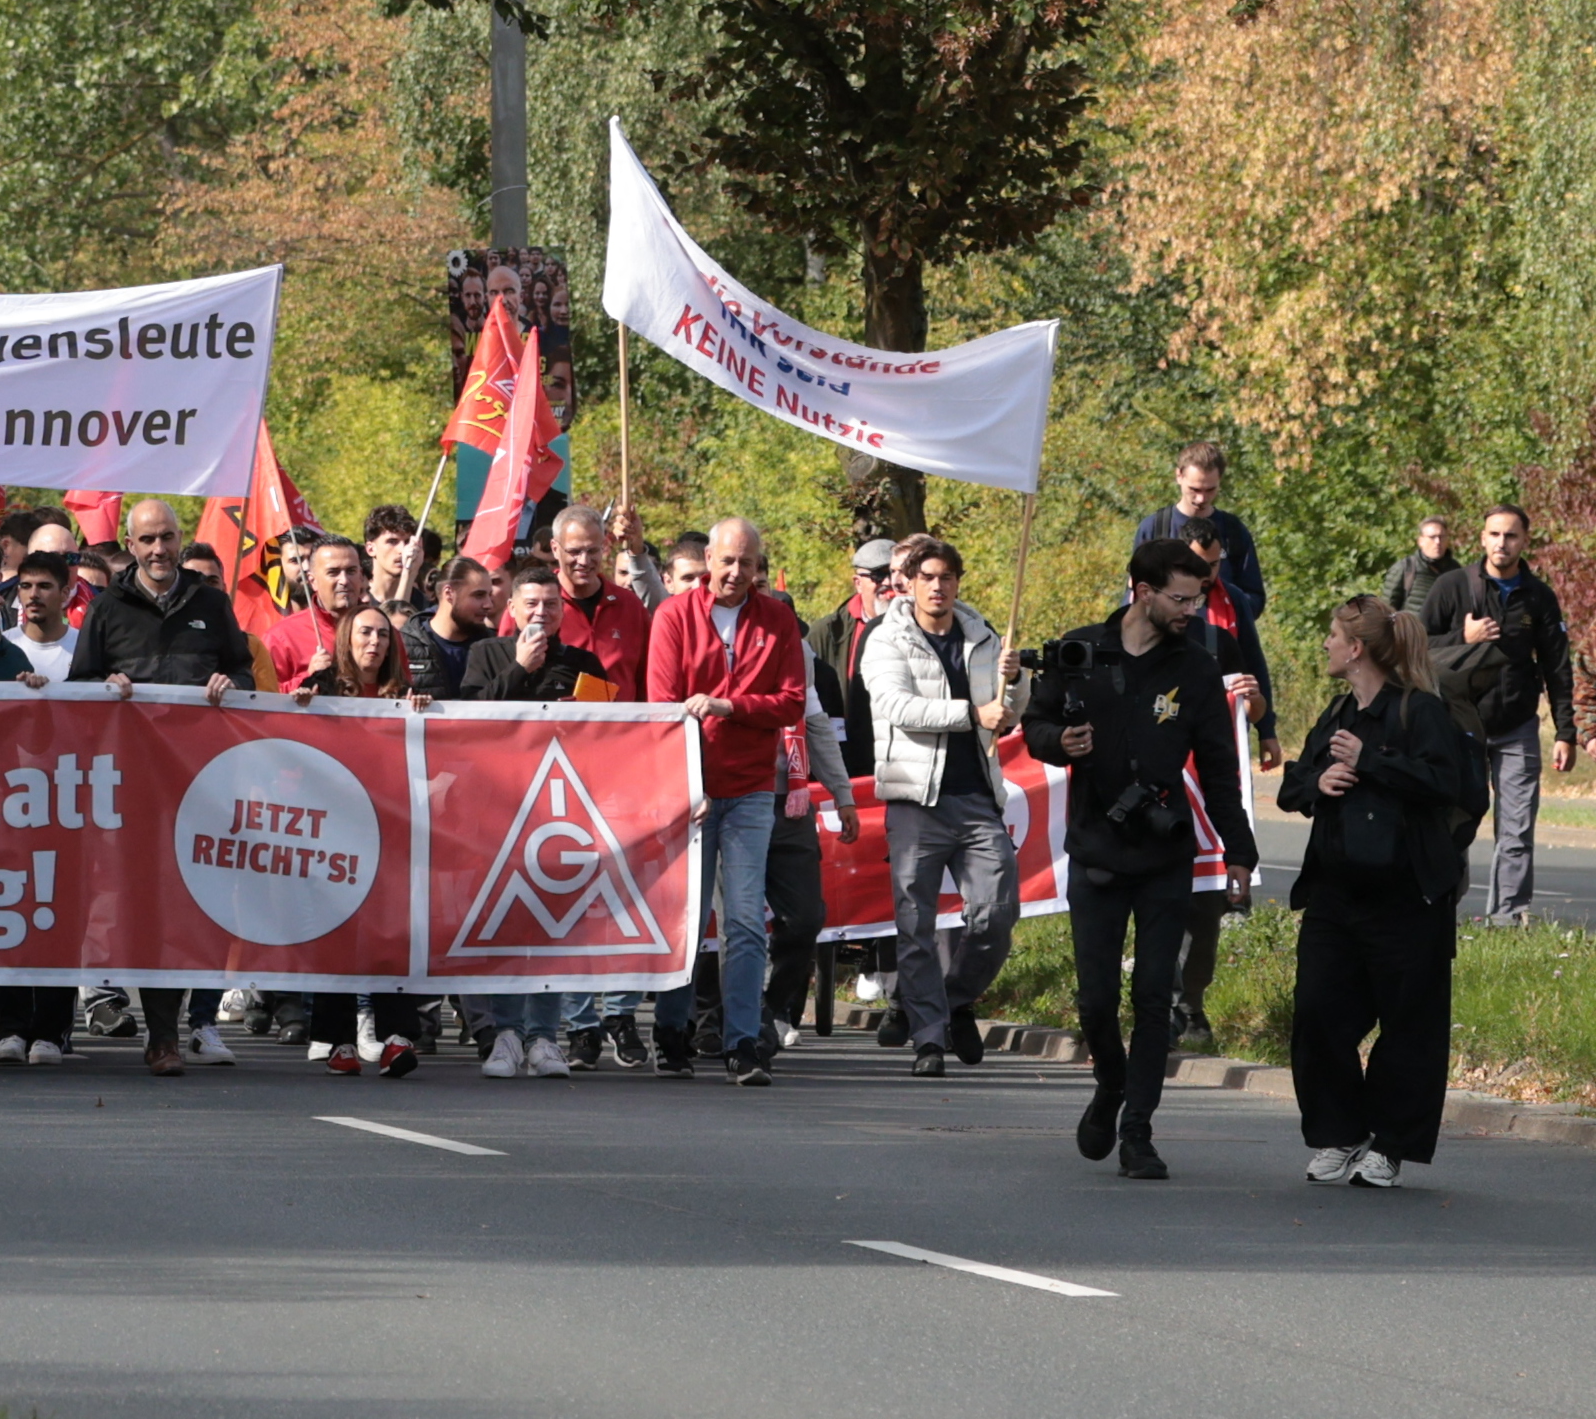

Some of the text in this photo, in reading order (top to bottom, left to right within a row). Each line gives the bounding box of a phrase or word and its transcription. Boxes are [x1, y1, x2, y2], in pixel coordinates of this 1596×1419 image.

[673, 304, 765, 398] KEINE
[229, 799, 327, 838] JETZT
[191, 834, 358, 885] REICHT'S!
